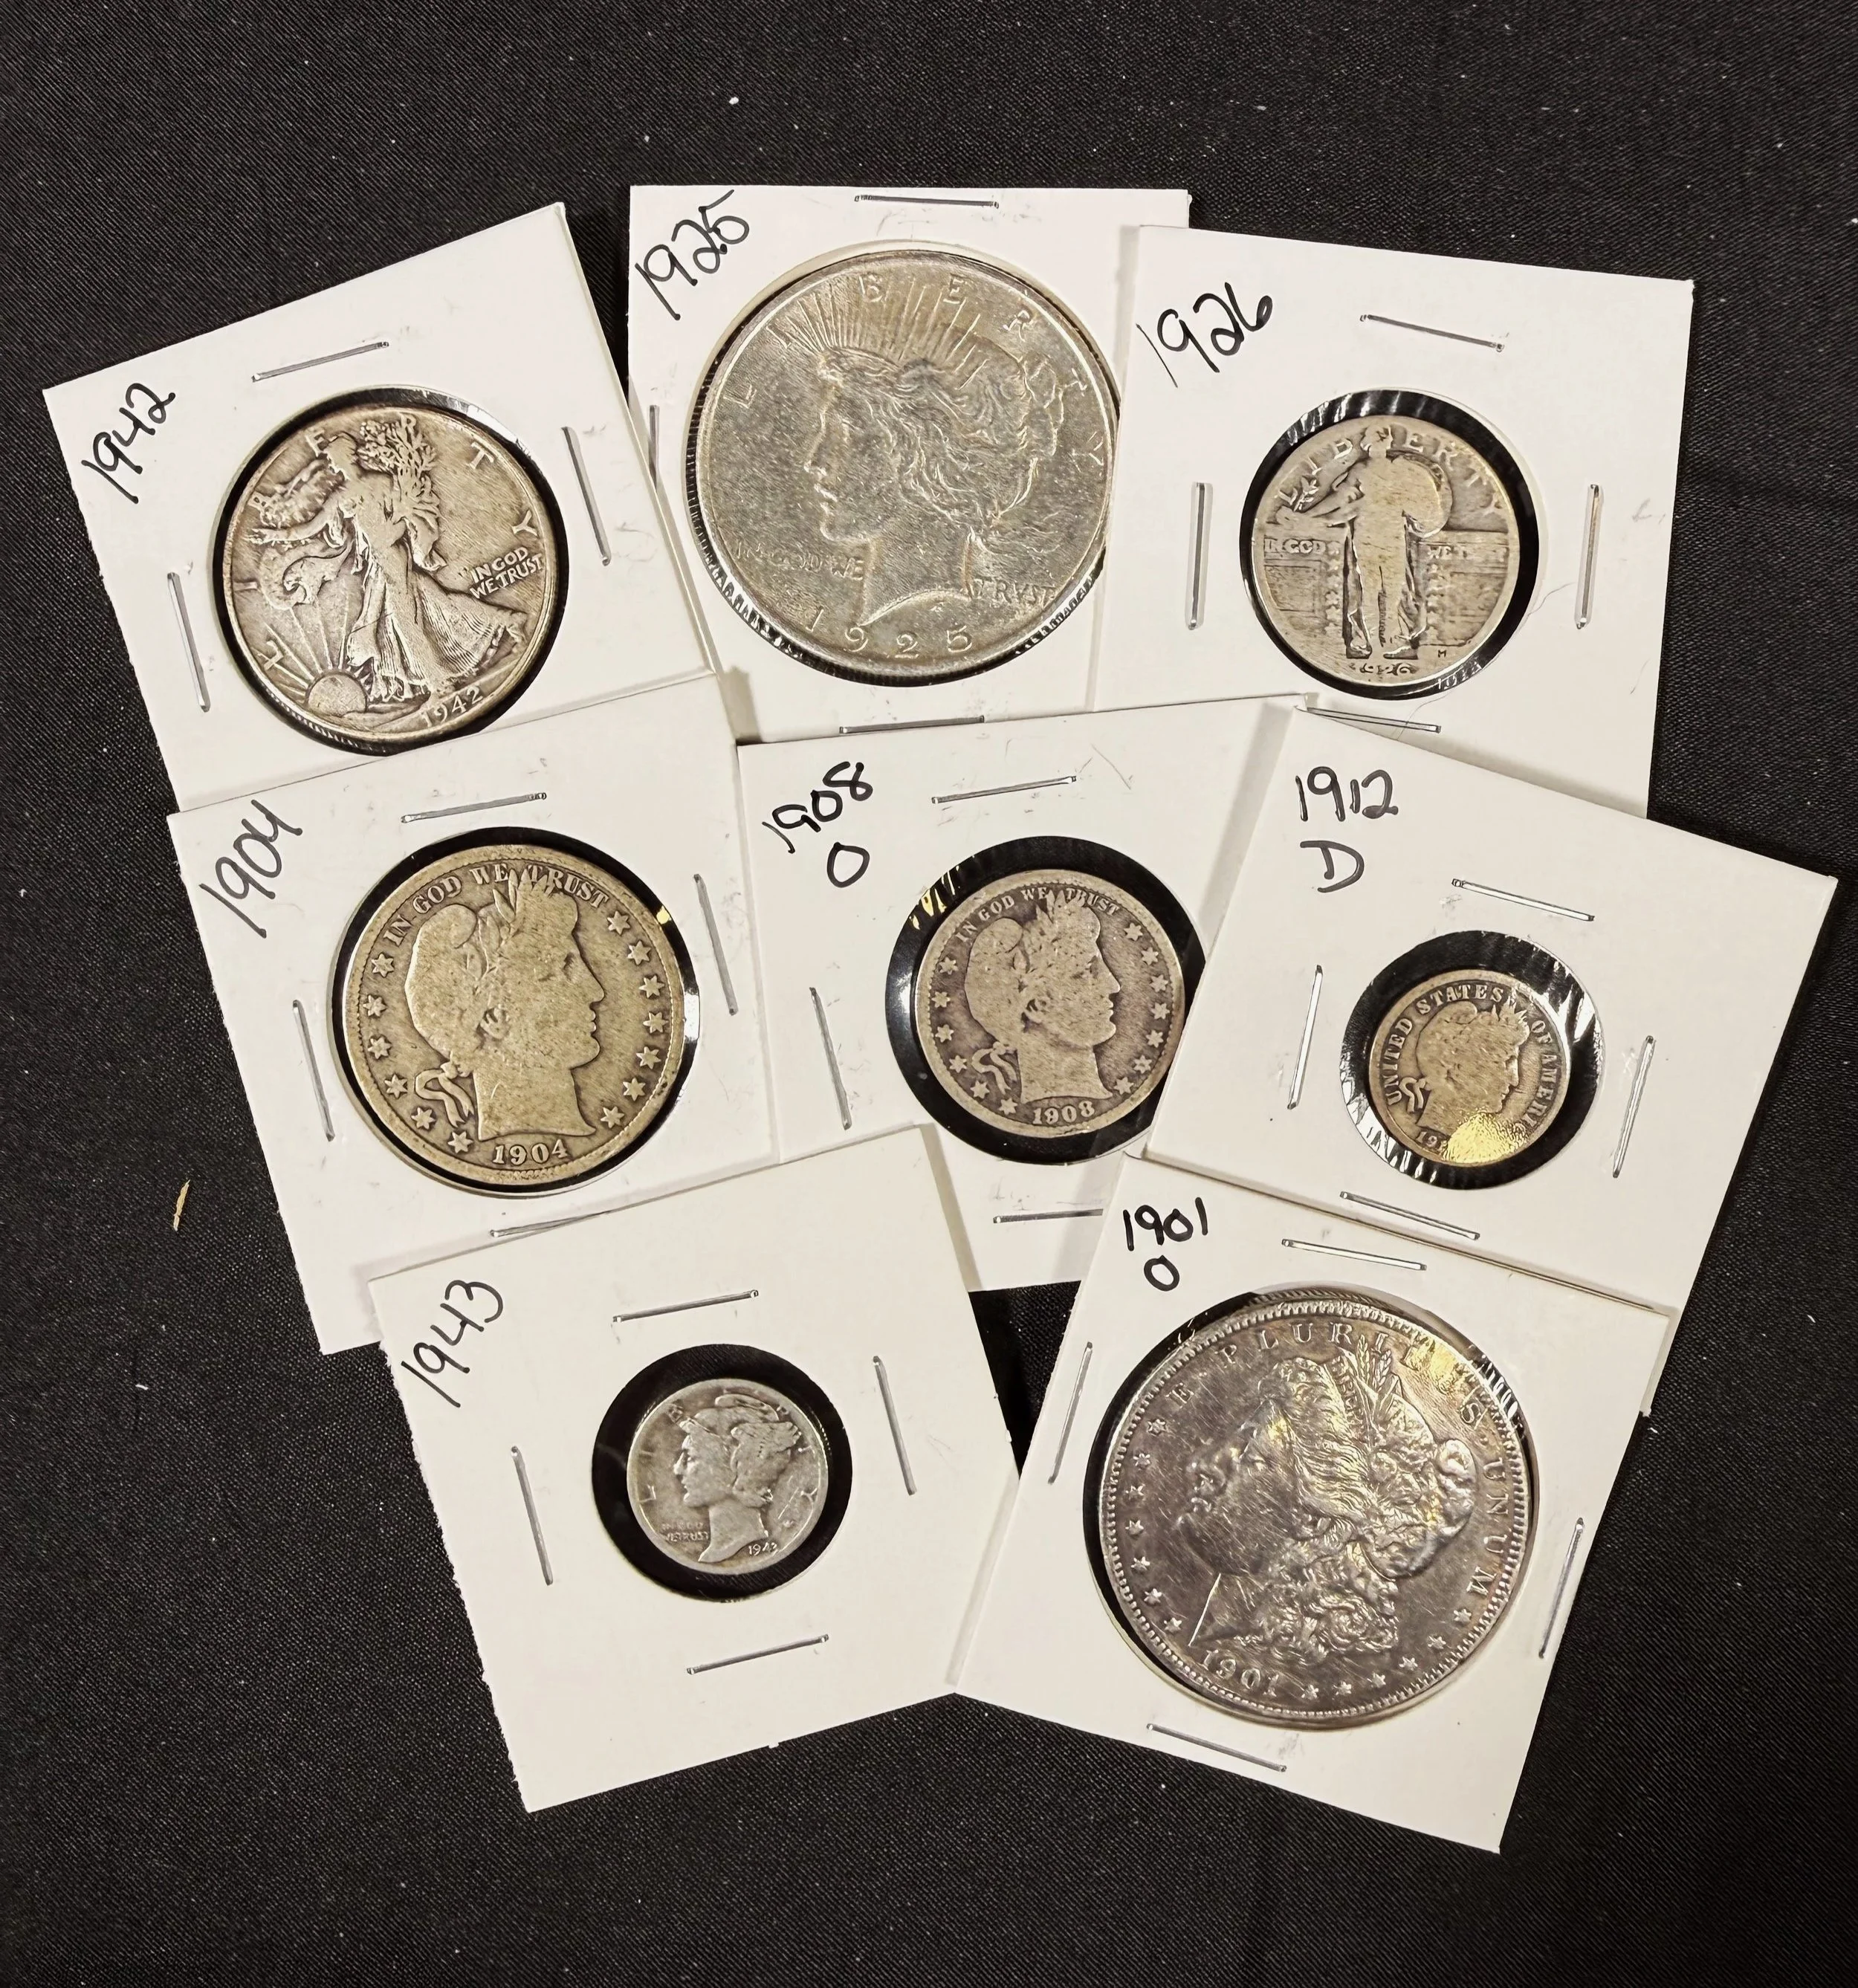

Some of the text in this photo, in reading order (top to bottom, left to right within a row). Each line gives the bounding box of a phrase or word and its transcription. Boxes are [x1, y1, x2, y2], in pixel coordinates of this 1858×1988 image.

[635, 190, 749, 320] 1925
[1136, 282, 1273, 387] 1926
[82, 383, 175, 504] 1942
[469, 553, 543, 599] WE TRUST
[470, 546, 528, 583] IN GOD
[806, 608, 972, 660] 1925
[421, 686, 484, 728] 1942
[763, 762, 873, 854] 1908
[1295, 767, 1399, 821] 1912
[199, 800, 302, 938] 1904
[1301, 841, 1365, 893] D
[383, 863, 609, 947] IN GOD WE TRUST
[955, 887, 1120, 943] IN GOD WE TRUST
[1382, 983, 1558, 1128] UNITED STATES OF AMERI
[1032, 1101, 1095, 1125] 1908
[492, 1139, 569, 1166] 1904
[1123, 1197, 1208, 1251] 1901
[401, 1280, 503, 1407] 1943
[1167, 1321, 1510, 1596] E PLURIS UNUM
[1203, 1648, 1279, 1697] 1901
